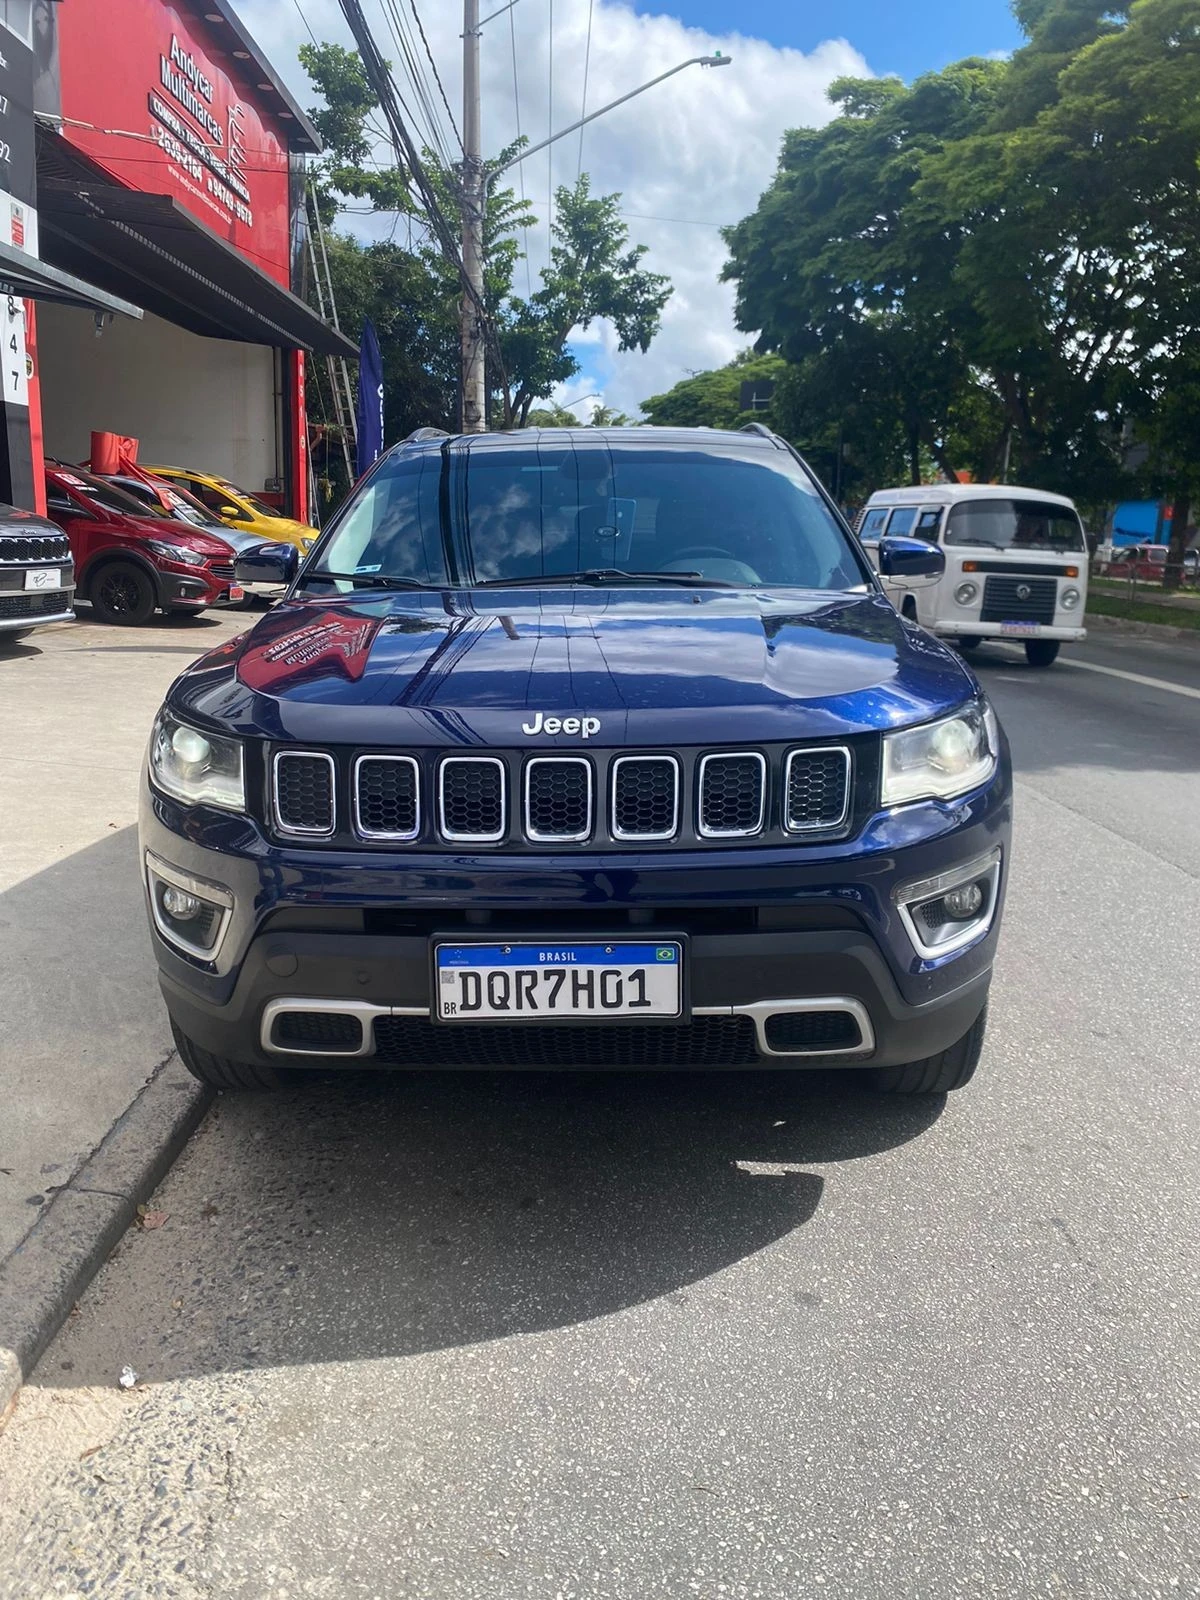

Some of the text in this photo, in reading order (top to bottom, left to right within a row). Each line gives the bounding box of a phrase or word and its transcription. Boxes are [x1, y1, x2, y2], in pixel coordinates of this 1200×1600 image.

[170, 33, 213, 104] Andycar
[161, 54, 223, 145] Multimarcas
[522, 713, 601, 739] Jeep
[539, 951, 577, 962] BRASIL
[459, 968, 652, 1011] DQR7H01
[443, 1002, 457, 1015] BR
